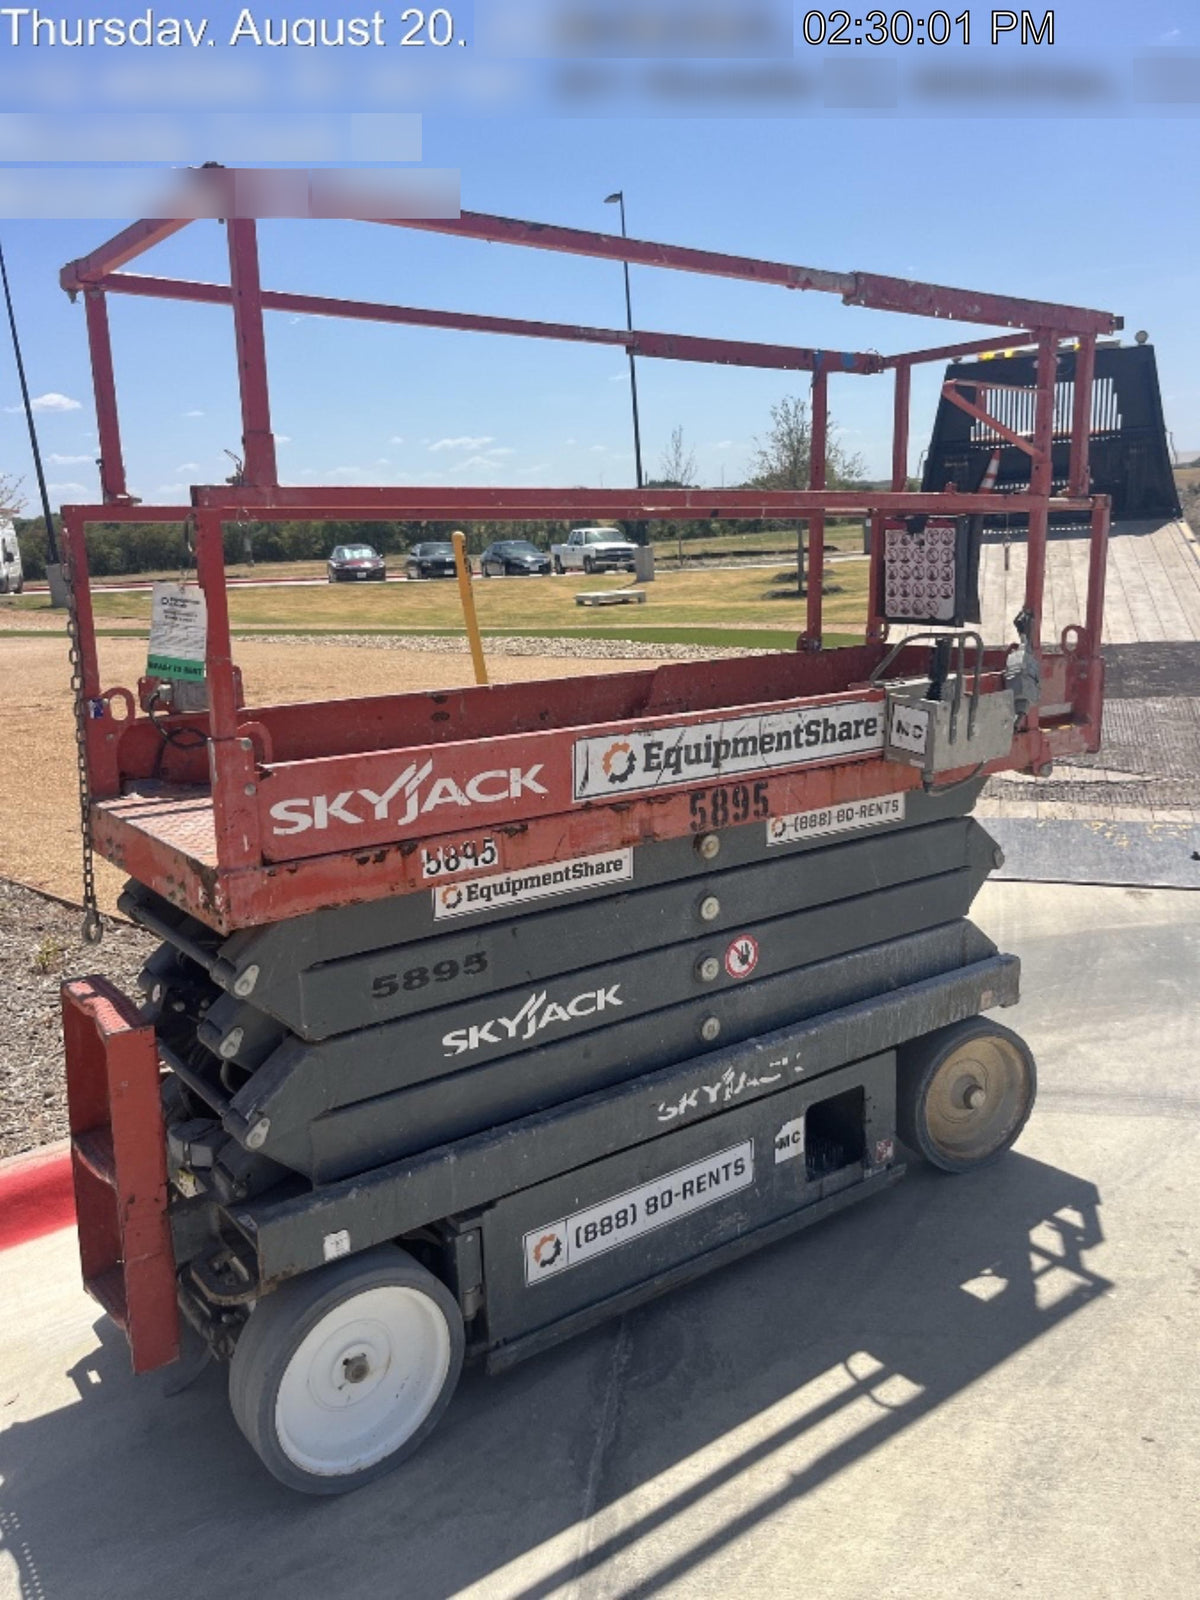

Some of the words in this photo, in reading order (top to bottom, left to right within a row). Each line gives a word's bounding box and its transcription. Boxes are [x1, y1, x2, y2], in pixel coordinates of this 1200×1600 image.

[642, 716, 878, 774] EquipmentShare
[269, 758, 549, 836] SKYJACK
[689, 781, 770, 832] 5895
[794, 810, 832, 833] (888)
[836, 799, 900, 823] 80-RENTS
[466, 857, 624, 902] EquipmentShare
[371, 951, 489, 999] 5895
[442, 983, 624, 1057] SKYJACK
[575, 1202, 638, 1249] (888)
[645, 1157, 747, 1217] 80-RENTS
